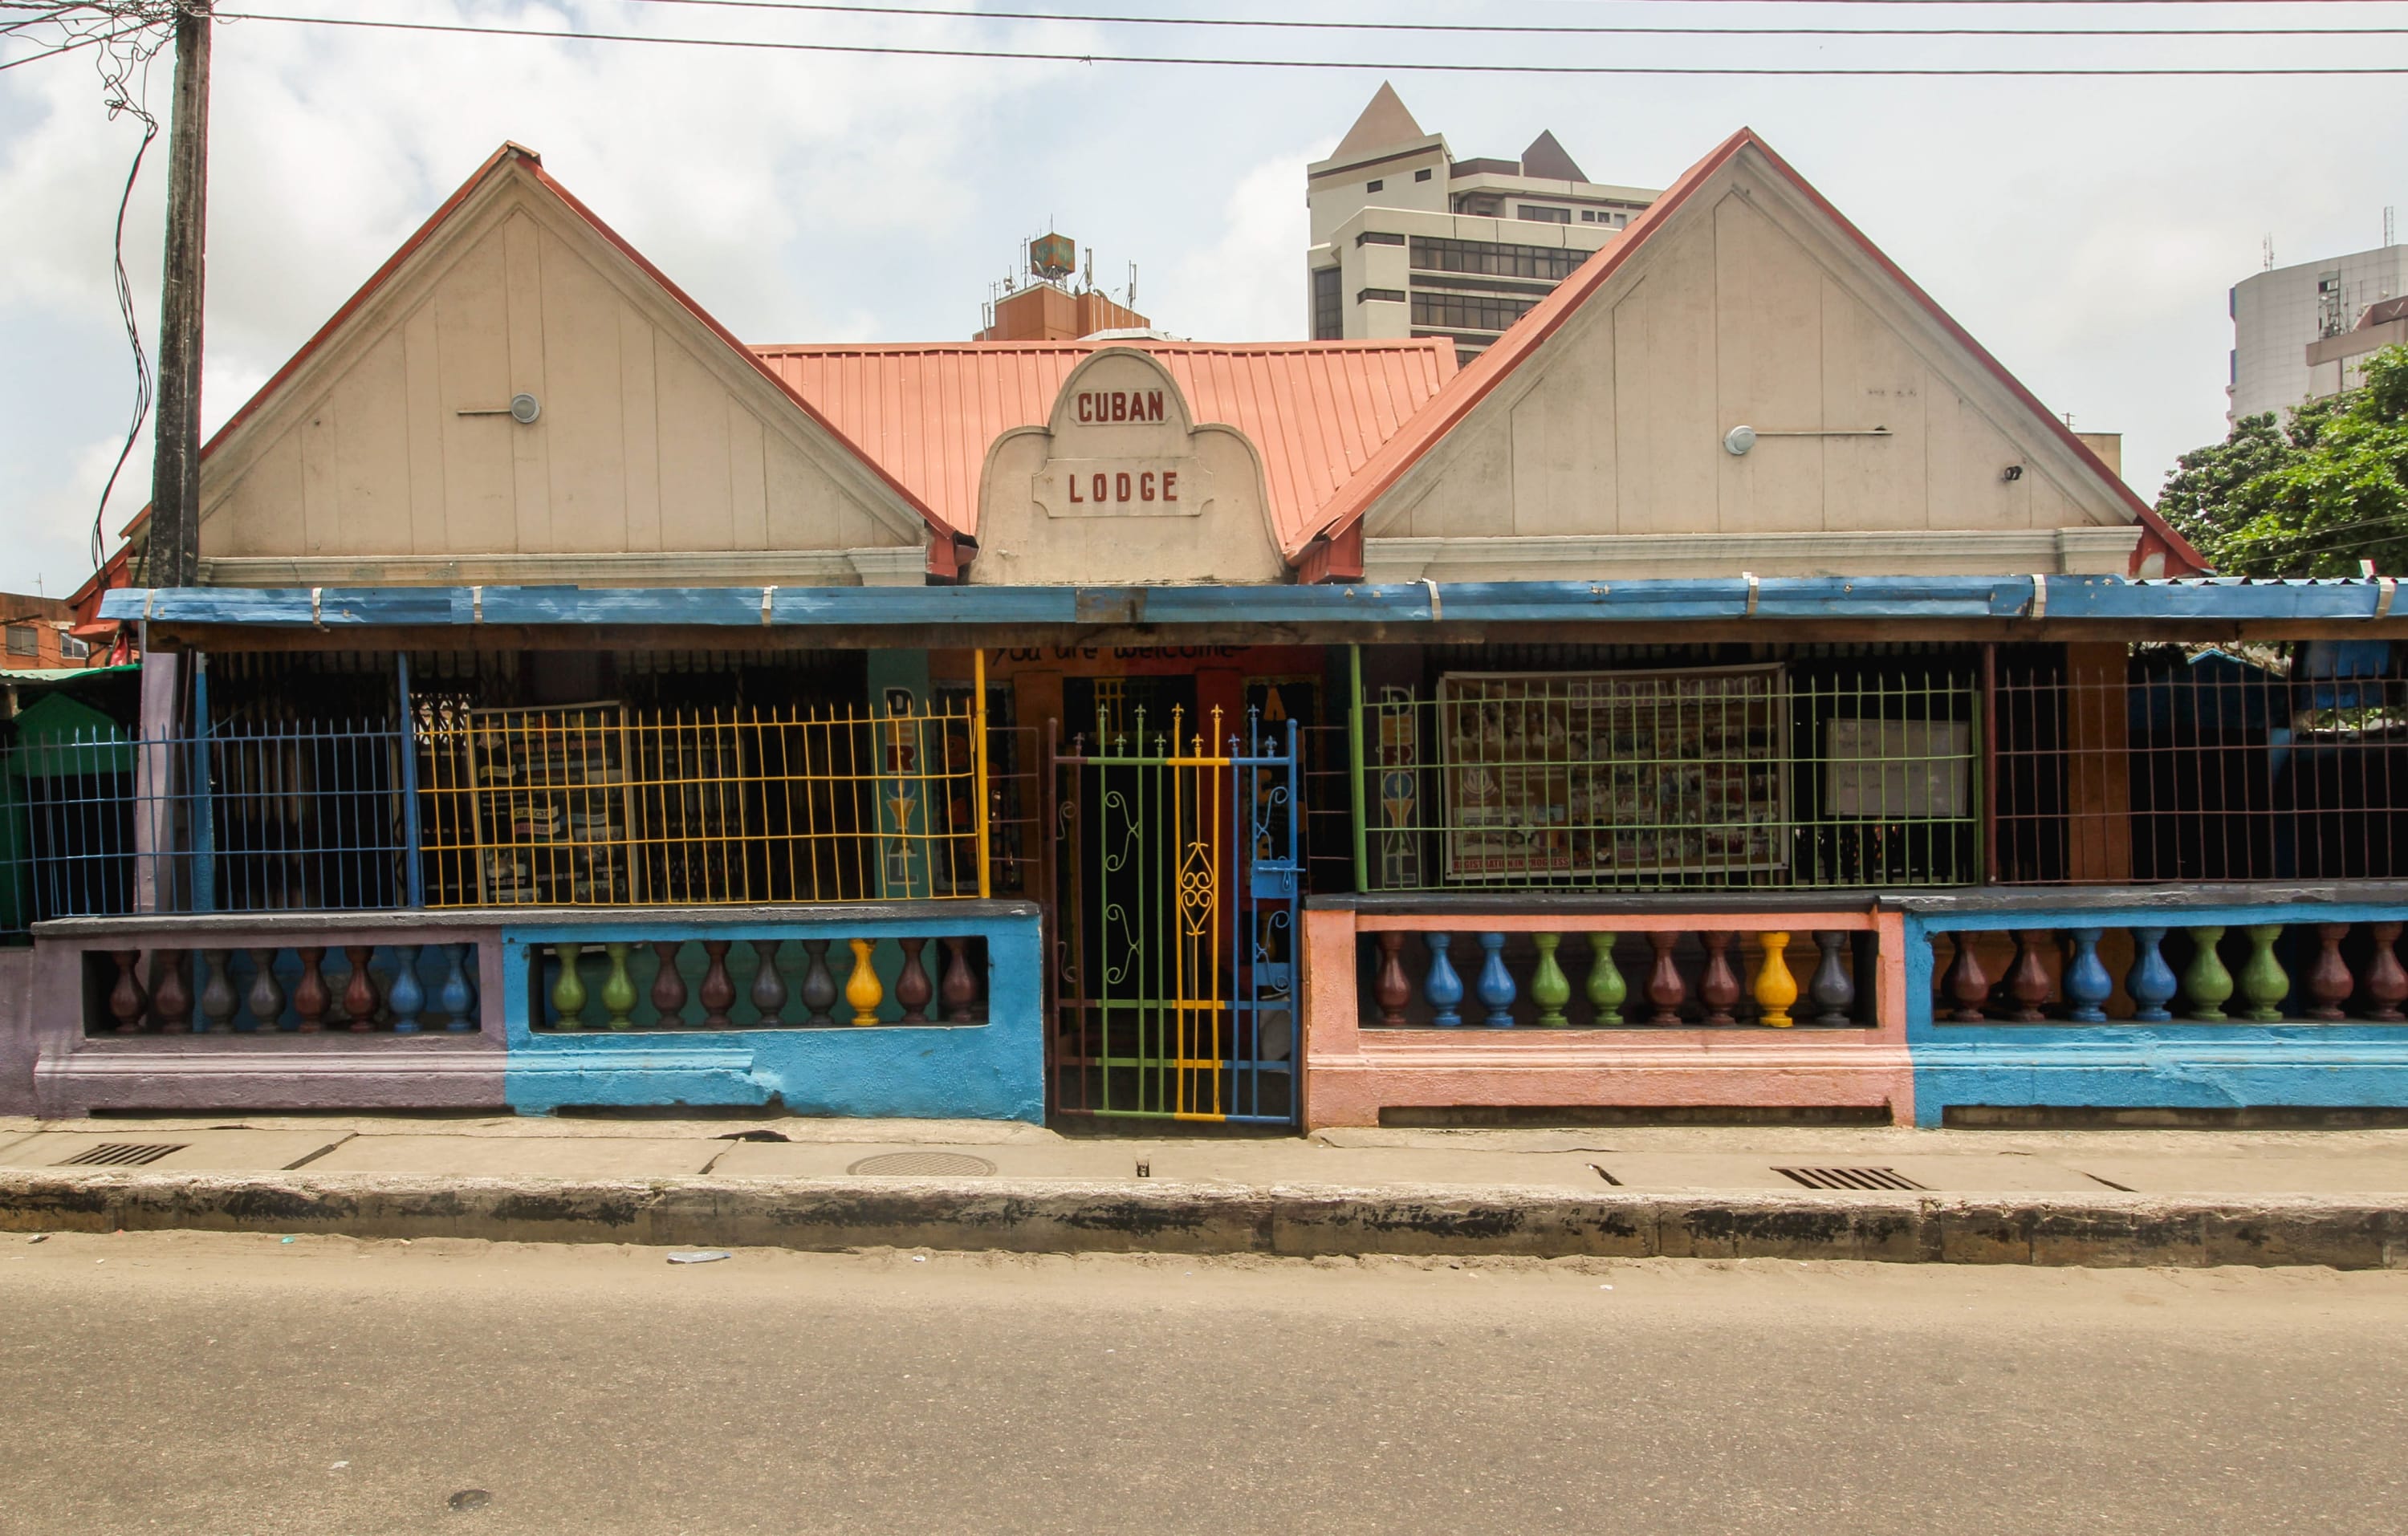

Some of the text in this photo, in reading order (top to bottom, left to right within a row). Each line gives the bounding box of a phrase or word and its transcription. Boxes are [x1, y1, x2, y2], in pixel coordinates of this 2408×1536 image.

[1078, 392, 1164, 422] CUBAN
[1069, 472, 1178, 502] LODGE
[884, 687, 919, 885] DEROYAL
[1380, 686, 1417, 884] DEROYAL
